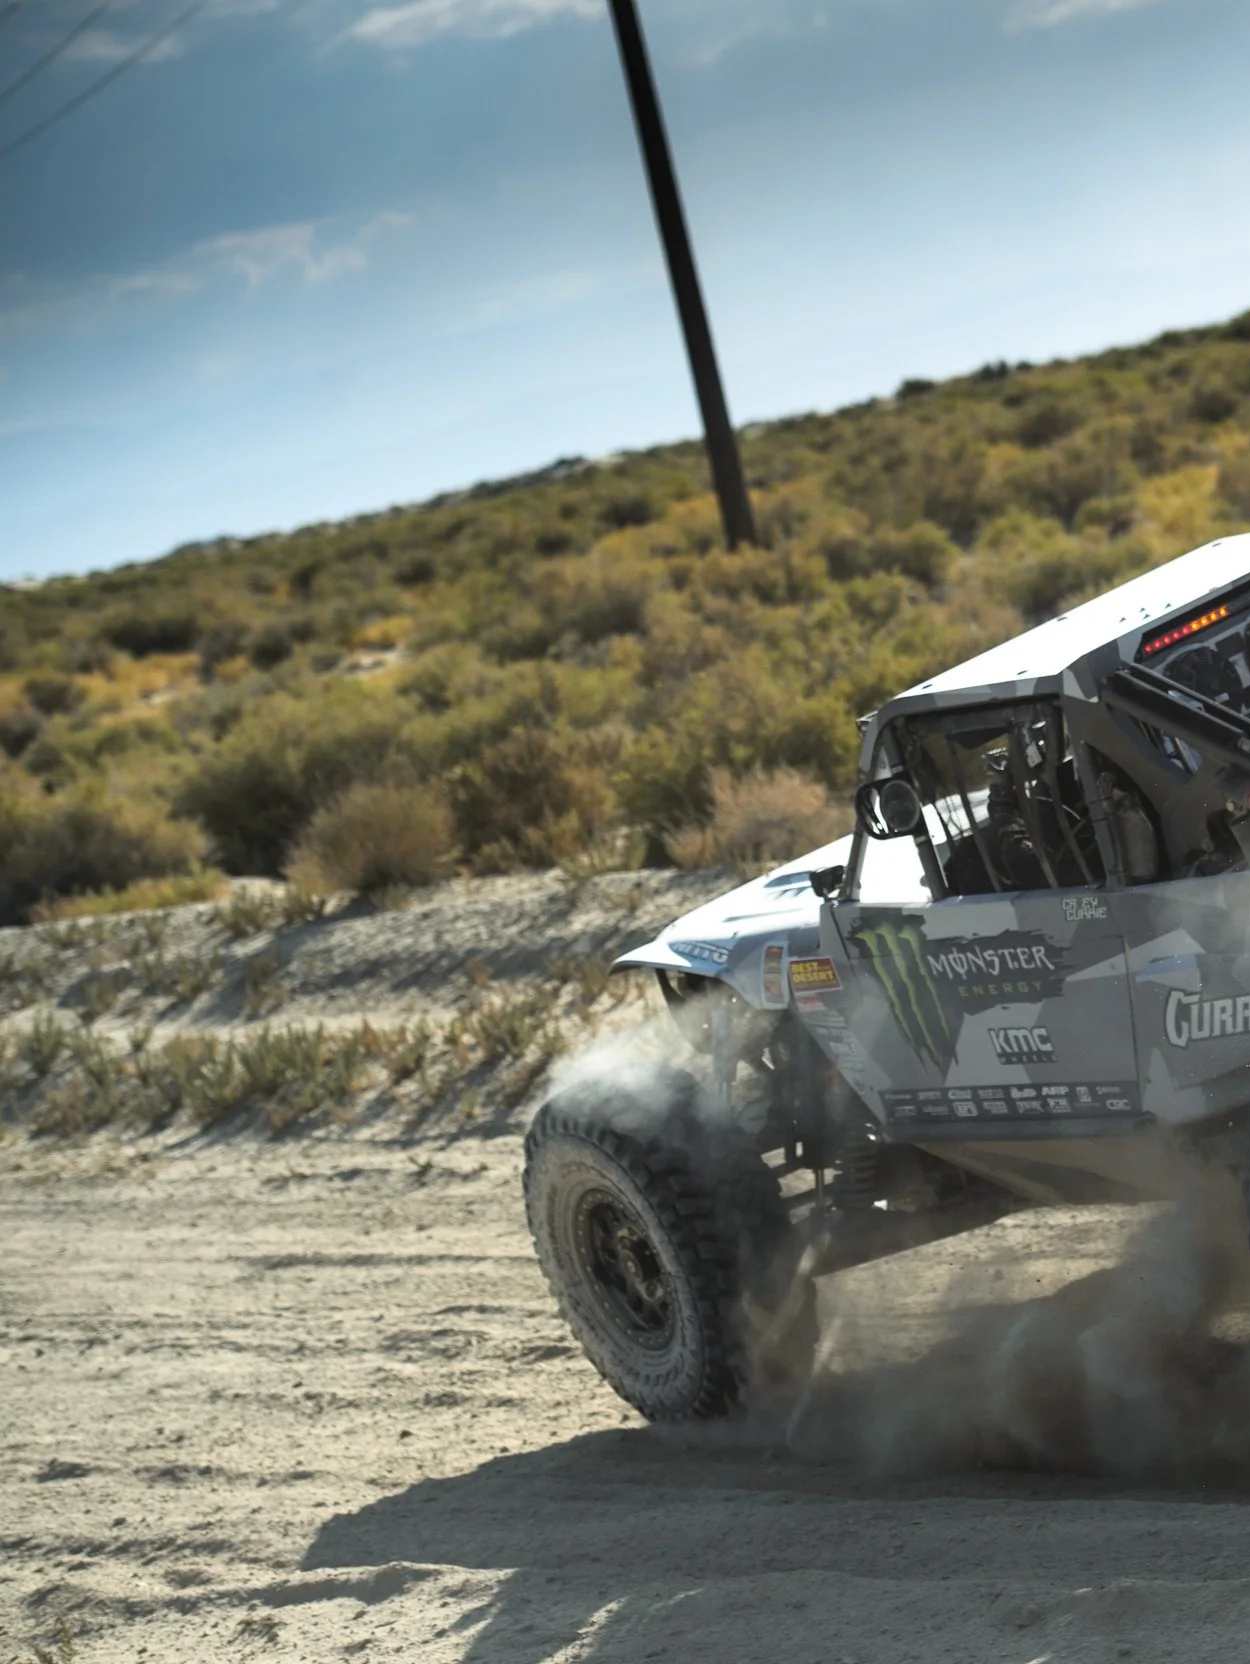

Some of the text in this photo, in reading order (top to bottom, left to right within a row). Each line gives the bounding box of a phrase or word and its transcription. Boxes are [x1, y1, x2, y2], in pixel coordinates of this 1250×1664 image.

[791, 961, 819, 975] BEST
[927, 944, 1055, 980] MONSTER
[792, 970, 834, 984] DESERT
[958, 980, 1042, 998] ENERGY
